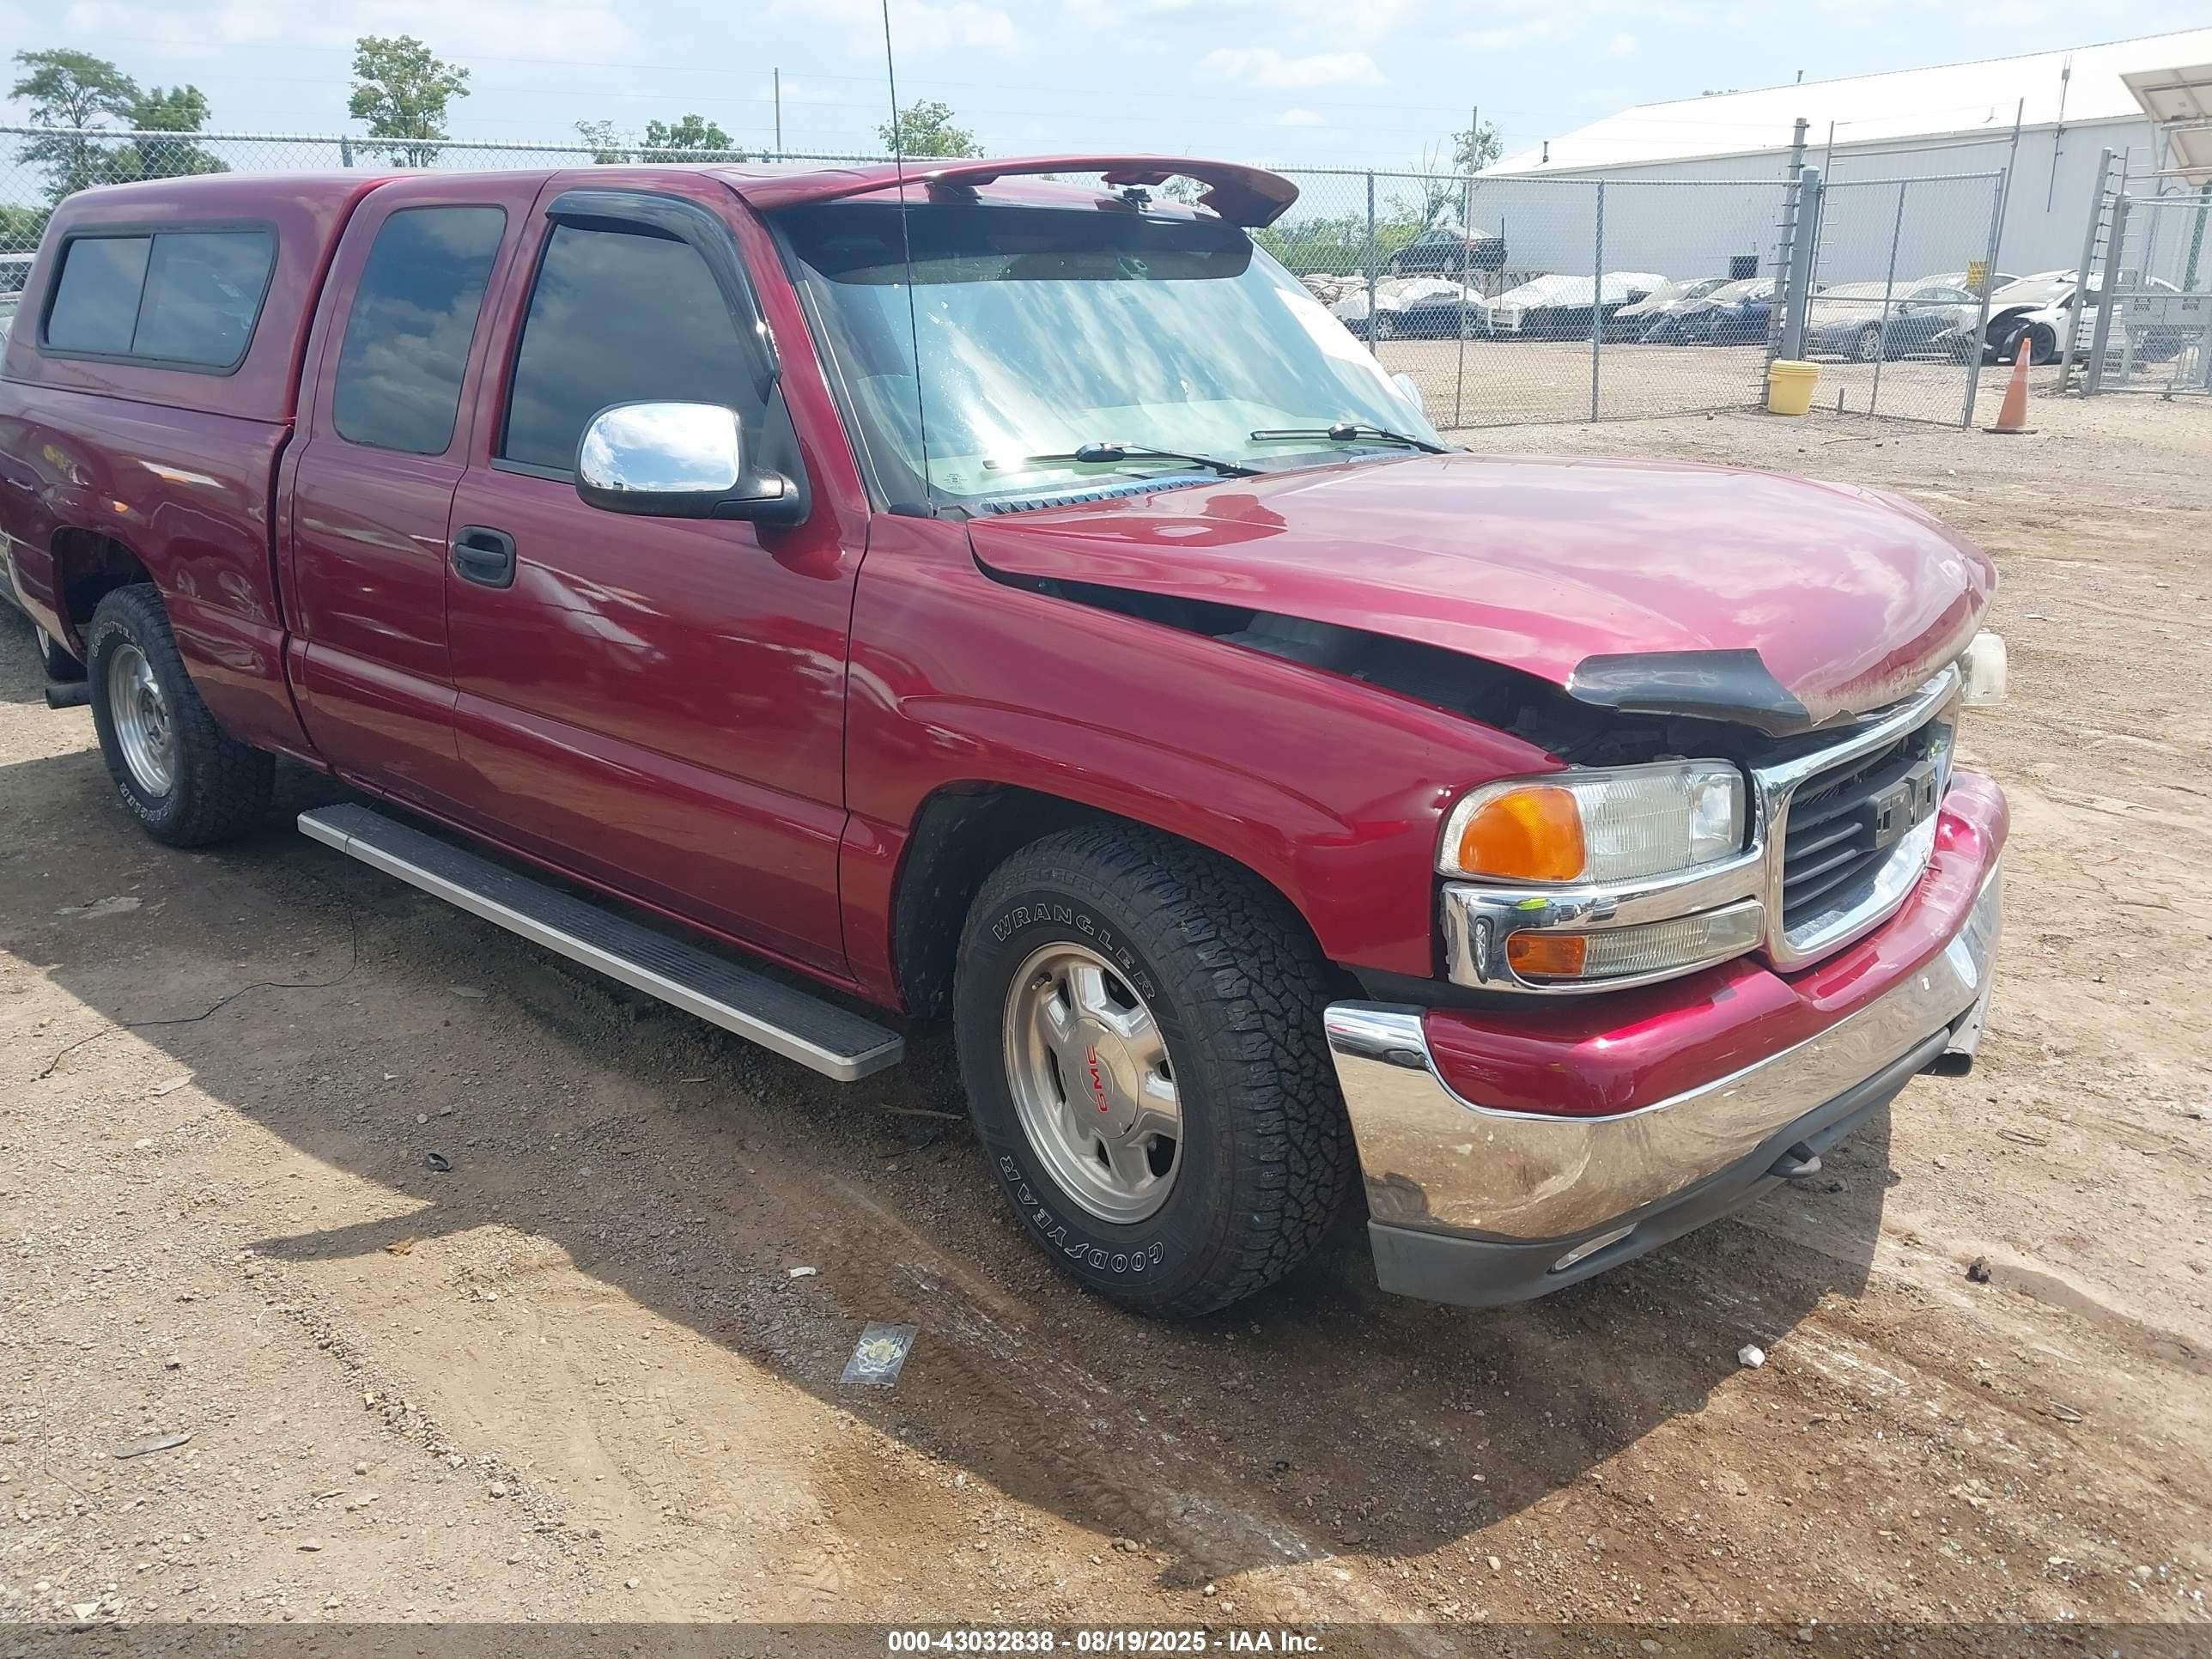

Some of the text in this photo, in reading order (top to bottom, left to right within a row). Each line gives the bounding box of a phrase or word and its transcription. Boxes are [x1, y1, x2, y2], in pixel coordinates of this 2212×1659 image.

[91, 620, 147, 660] GOODYEAR
[992, 903, 1156, 1000] WRANGLER
[1085, 1043, 1109, 1113] GMC
[1000, 1155, 1164, 1273] GOODYEAR
